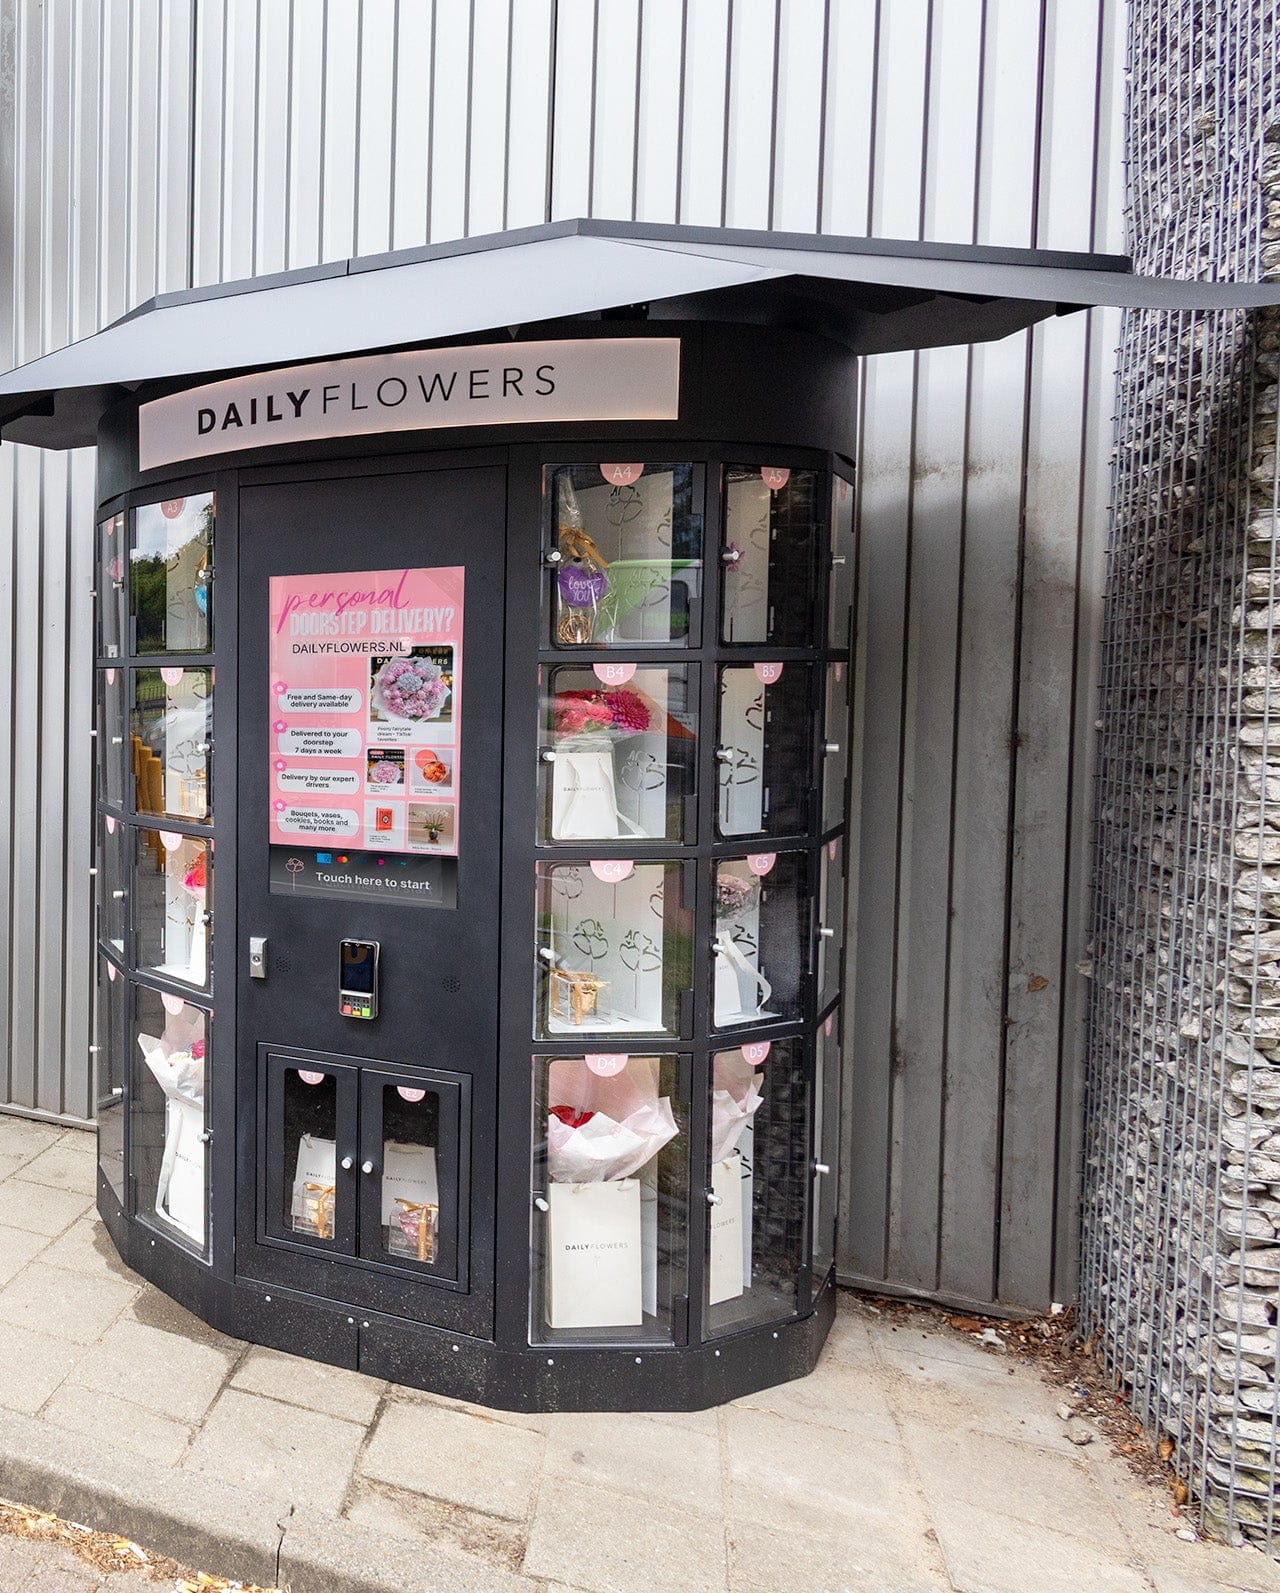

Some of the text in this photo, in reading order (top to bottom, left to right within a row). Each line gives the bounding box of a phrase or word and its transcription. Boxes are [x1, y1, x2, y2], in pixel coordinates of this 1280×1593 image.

[198, 365, 556, 435] DAILYFLOWERS
[612, 466, 631, 478] A4
[770, 470, 782, 482] A5
[167, 501, 178, 513] A3
[277, 569, 411, 634] personal
[290, 607, 455, 637] DOORSTEP DELIVERY?
[292, 641, 406, 654] DAILYFLOWERS.NL
[606, 666, 625, 679] B4
[762, 666, 775, 677] B5
[317, 694, 353, 702] Same-day
[300, 747, 316, 755] days
[309, 774, 318, 782] by
[285, 817, 313, 825] cookies,
[313, 818, 335, 826] books
[321, 812, 343, 820] vases,
[602, 862, 621, 875] C4
[755, 857, 769, 869] C5
[316, 872, 431, 890] Touch here to start
[749, 1046, 763, 1059] D5
[597, 1057, 617, 1070] D4
[565, 1241, 629, 1251] DAILYFLOWERS
